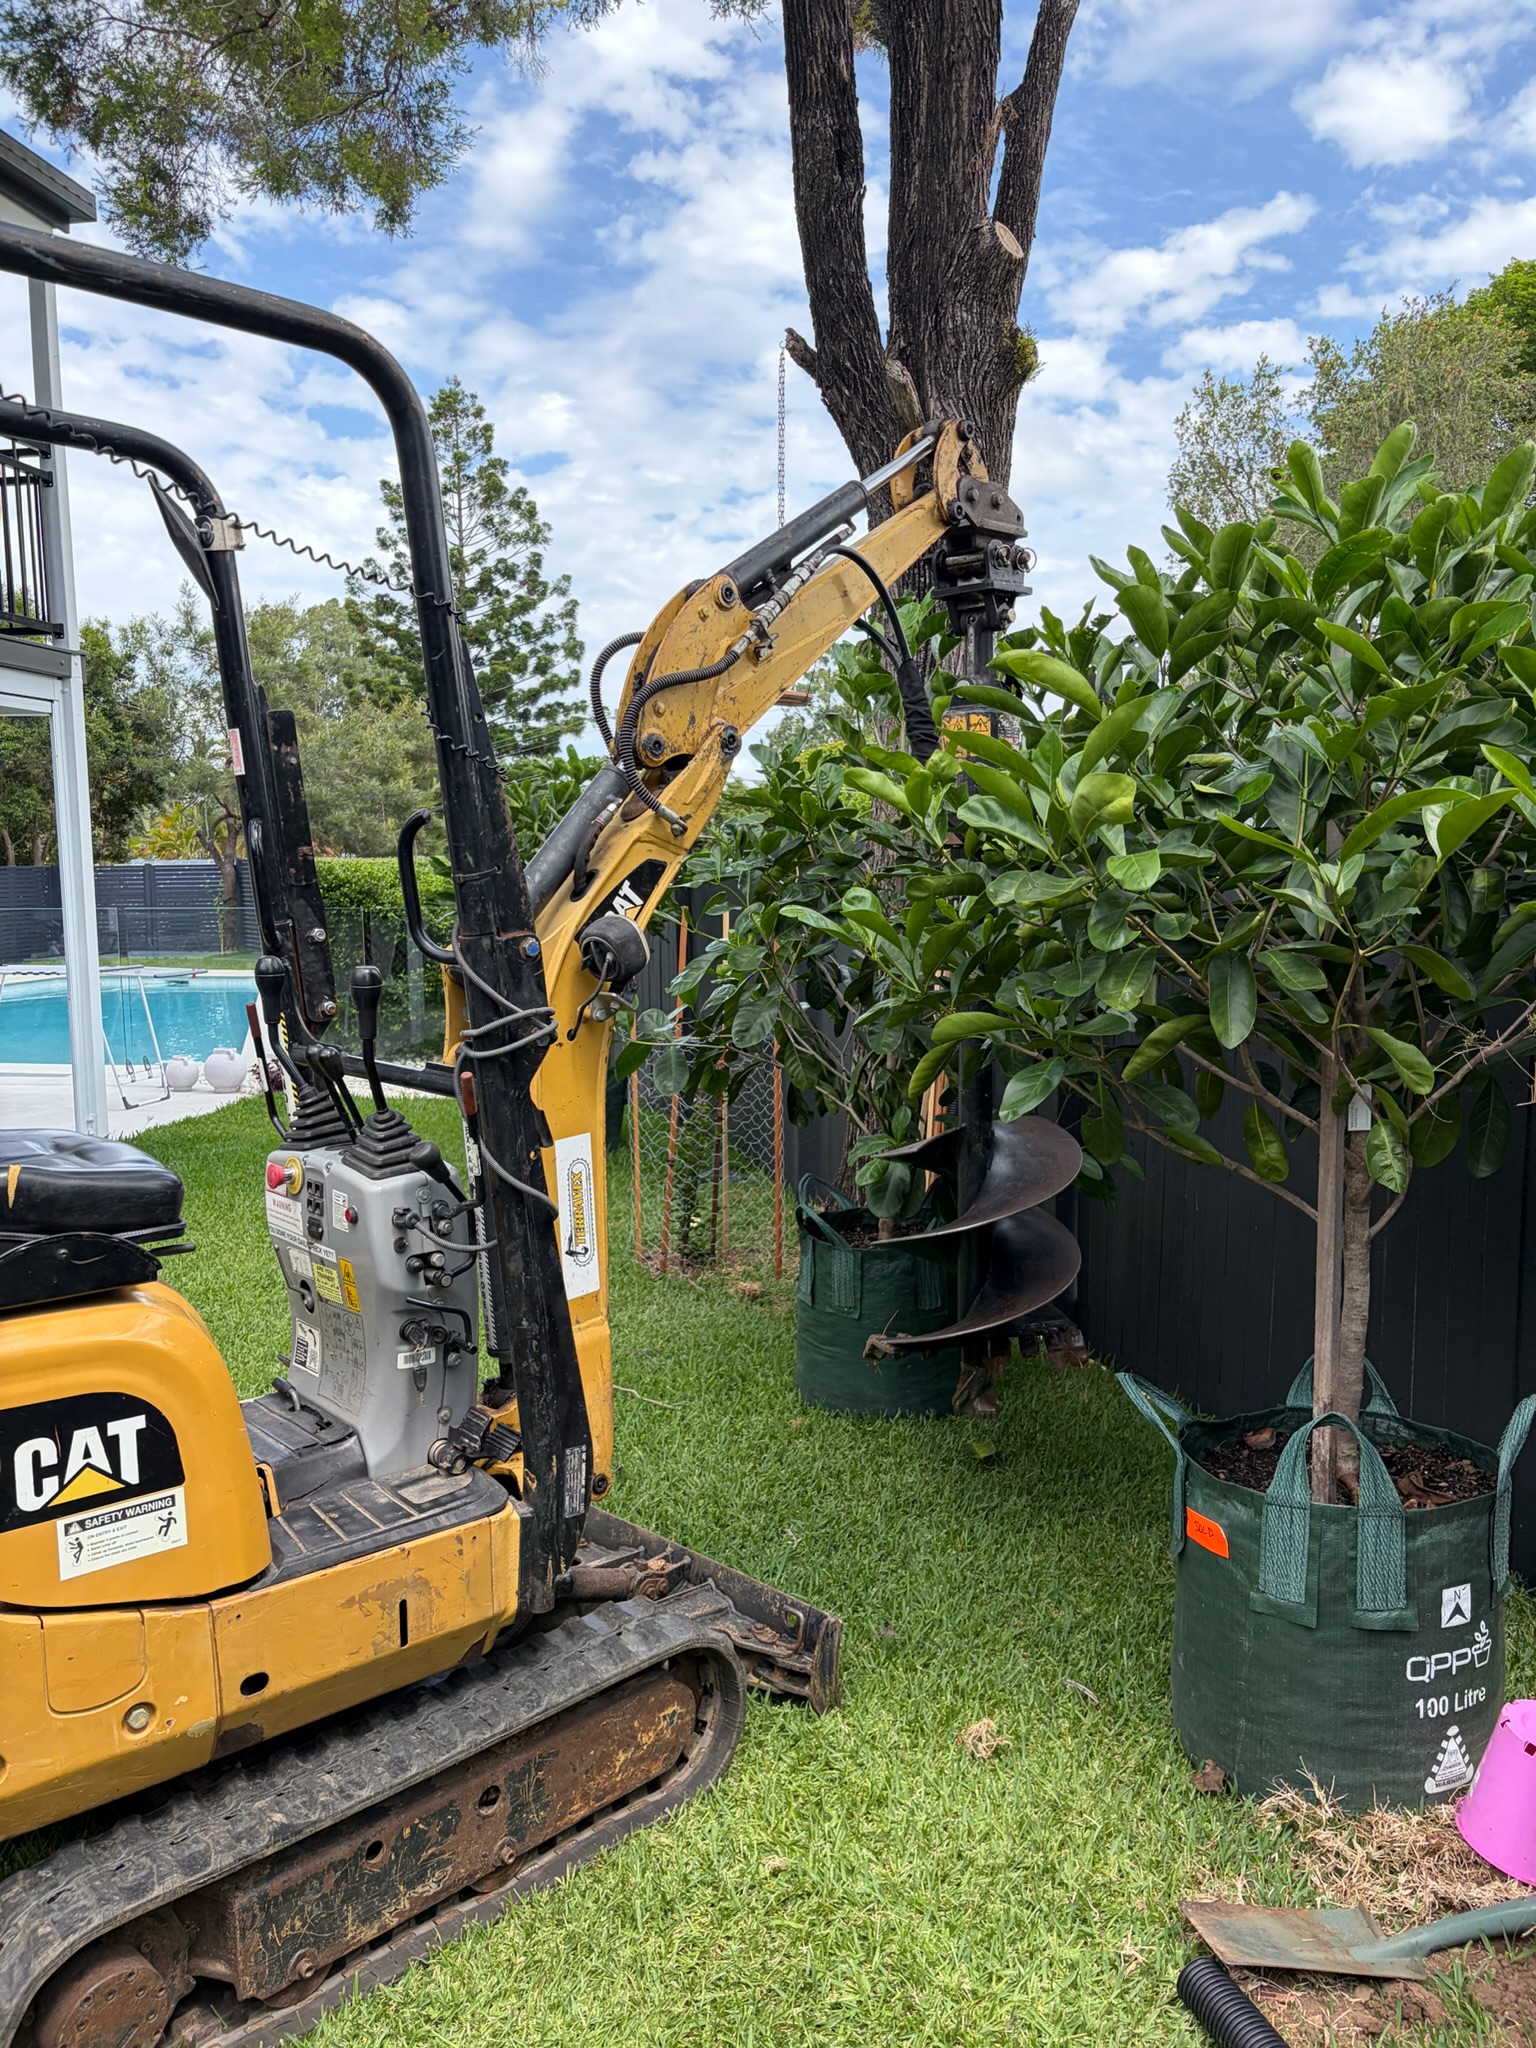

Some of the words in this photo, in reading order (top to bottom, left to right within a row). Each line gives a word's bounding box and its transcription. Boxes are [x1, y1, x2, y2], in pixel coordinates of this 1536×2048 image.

[604, 880, 644, 918] AT
[571, 1170, 587, 1247] TERRAVEX
[14, 1414, 147, 1512] CAT
[85, 1512, 124, 1529] SAFETY
[125, 1498, 172, 1517] WARNING
[1195, 1521, 1213, 1537] SOLD
[95, 1529, 112, 1538] ENTRY
[116, 1524, 128, 1532] EXIT
[1454, 1589, 1461, 1602] N
[1406, 1647, 1471, 1683] QPP
[1415, 1695, 1449, 1719] 100
[1454, 1686, 1487, 1713] Litre
[1434, 1773, 1467, 1788] WARNING
